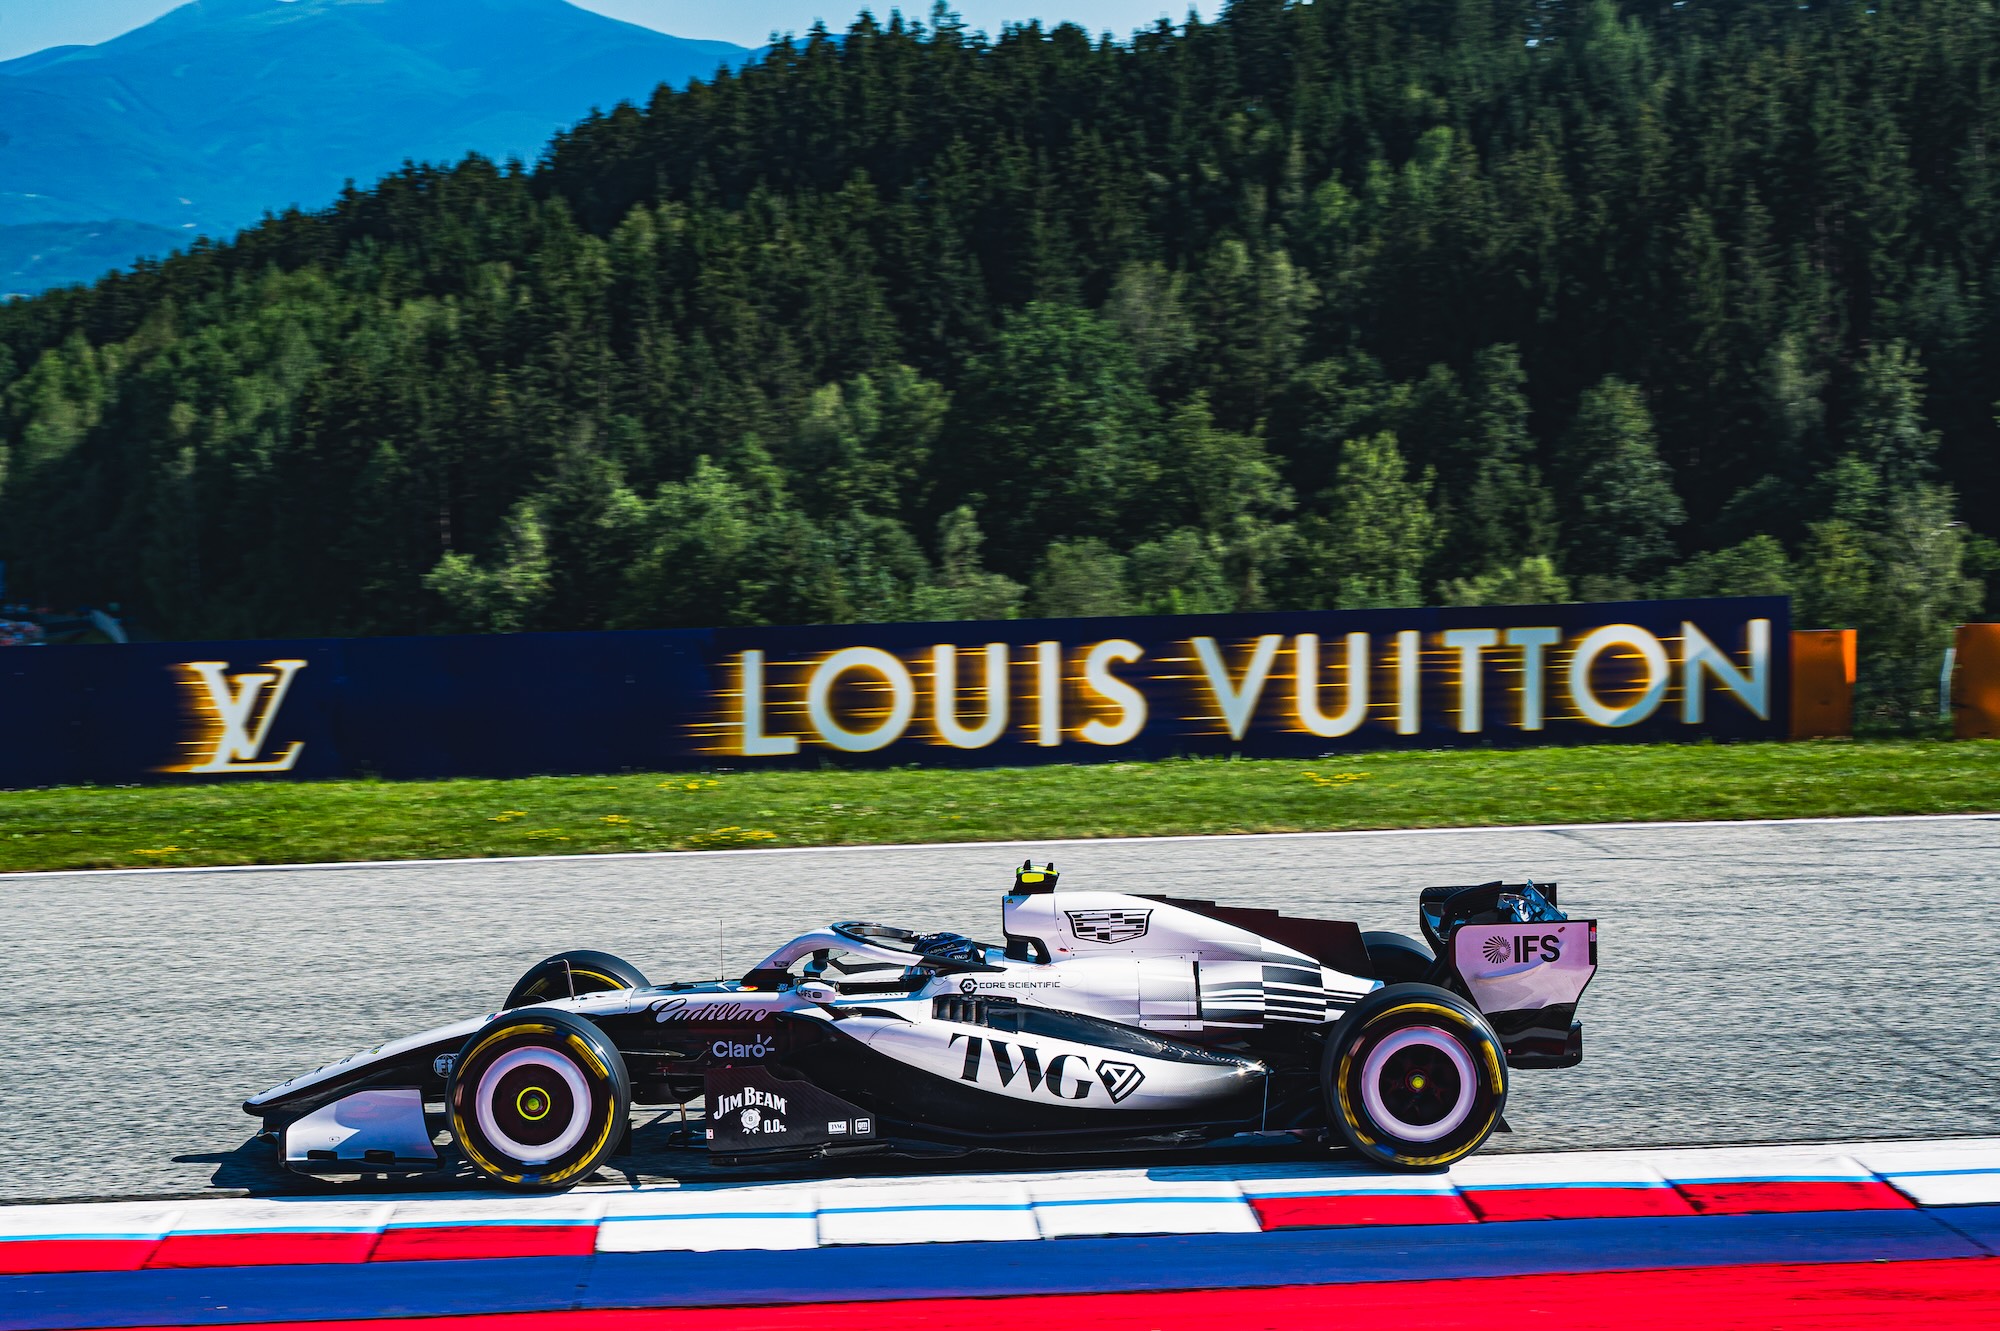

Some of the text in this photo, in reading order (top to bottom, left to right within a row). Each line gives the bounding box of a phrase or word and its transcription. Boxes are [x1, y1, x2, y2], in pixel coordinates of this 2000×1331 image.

[742, 617, 1771, 757] LOUIS VUITTON
[1513, 934, 1561, 964] IFS
[1008, 981, 1061, 989] SCIENTIFIC
[650, 998, 767, 1024] Cadillac
[712, 1040, 766, 1058] Claro
[948, 1033, 1094, 1100] TWG
[713, 1094, 744, 1120] JIM
[744, 1086, 787, 1115] BEAM
[764, 1119, 787, 1134] 0.0%
[857, 1121, 868, 1130] gm
